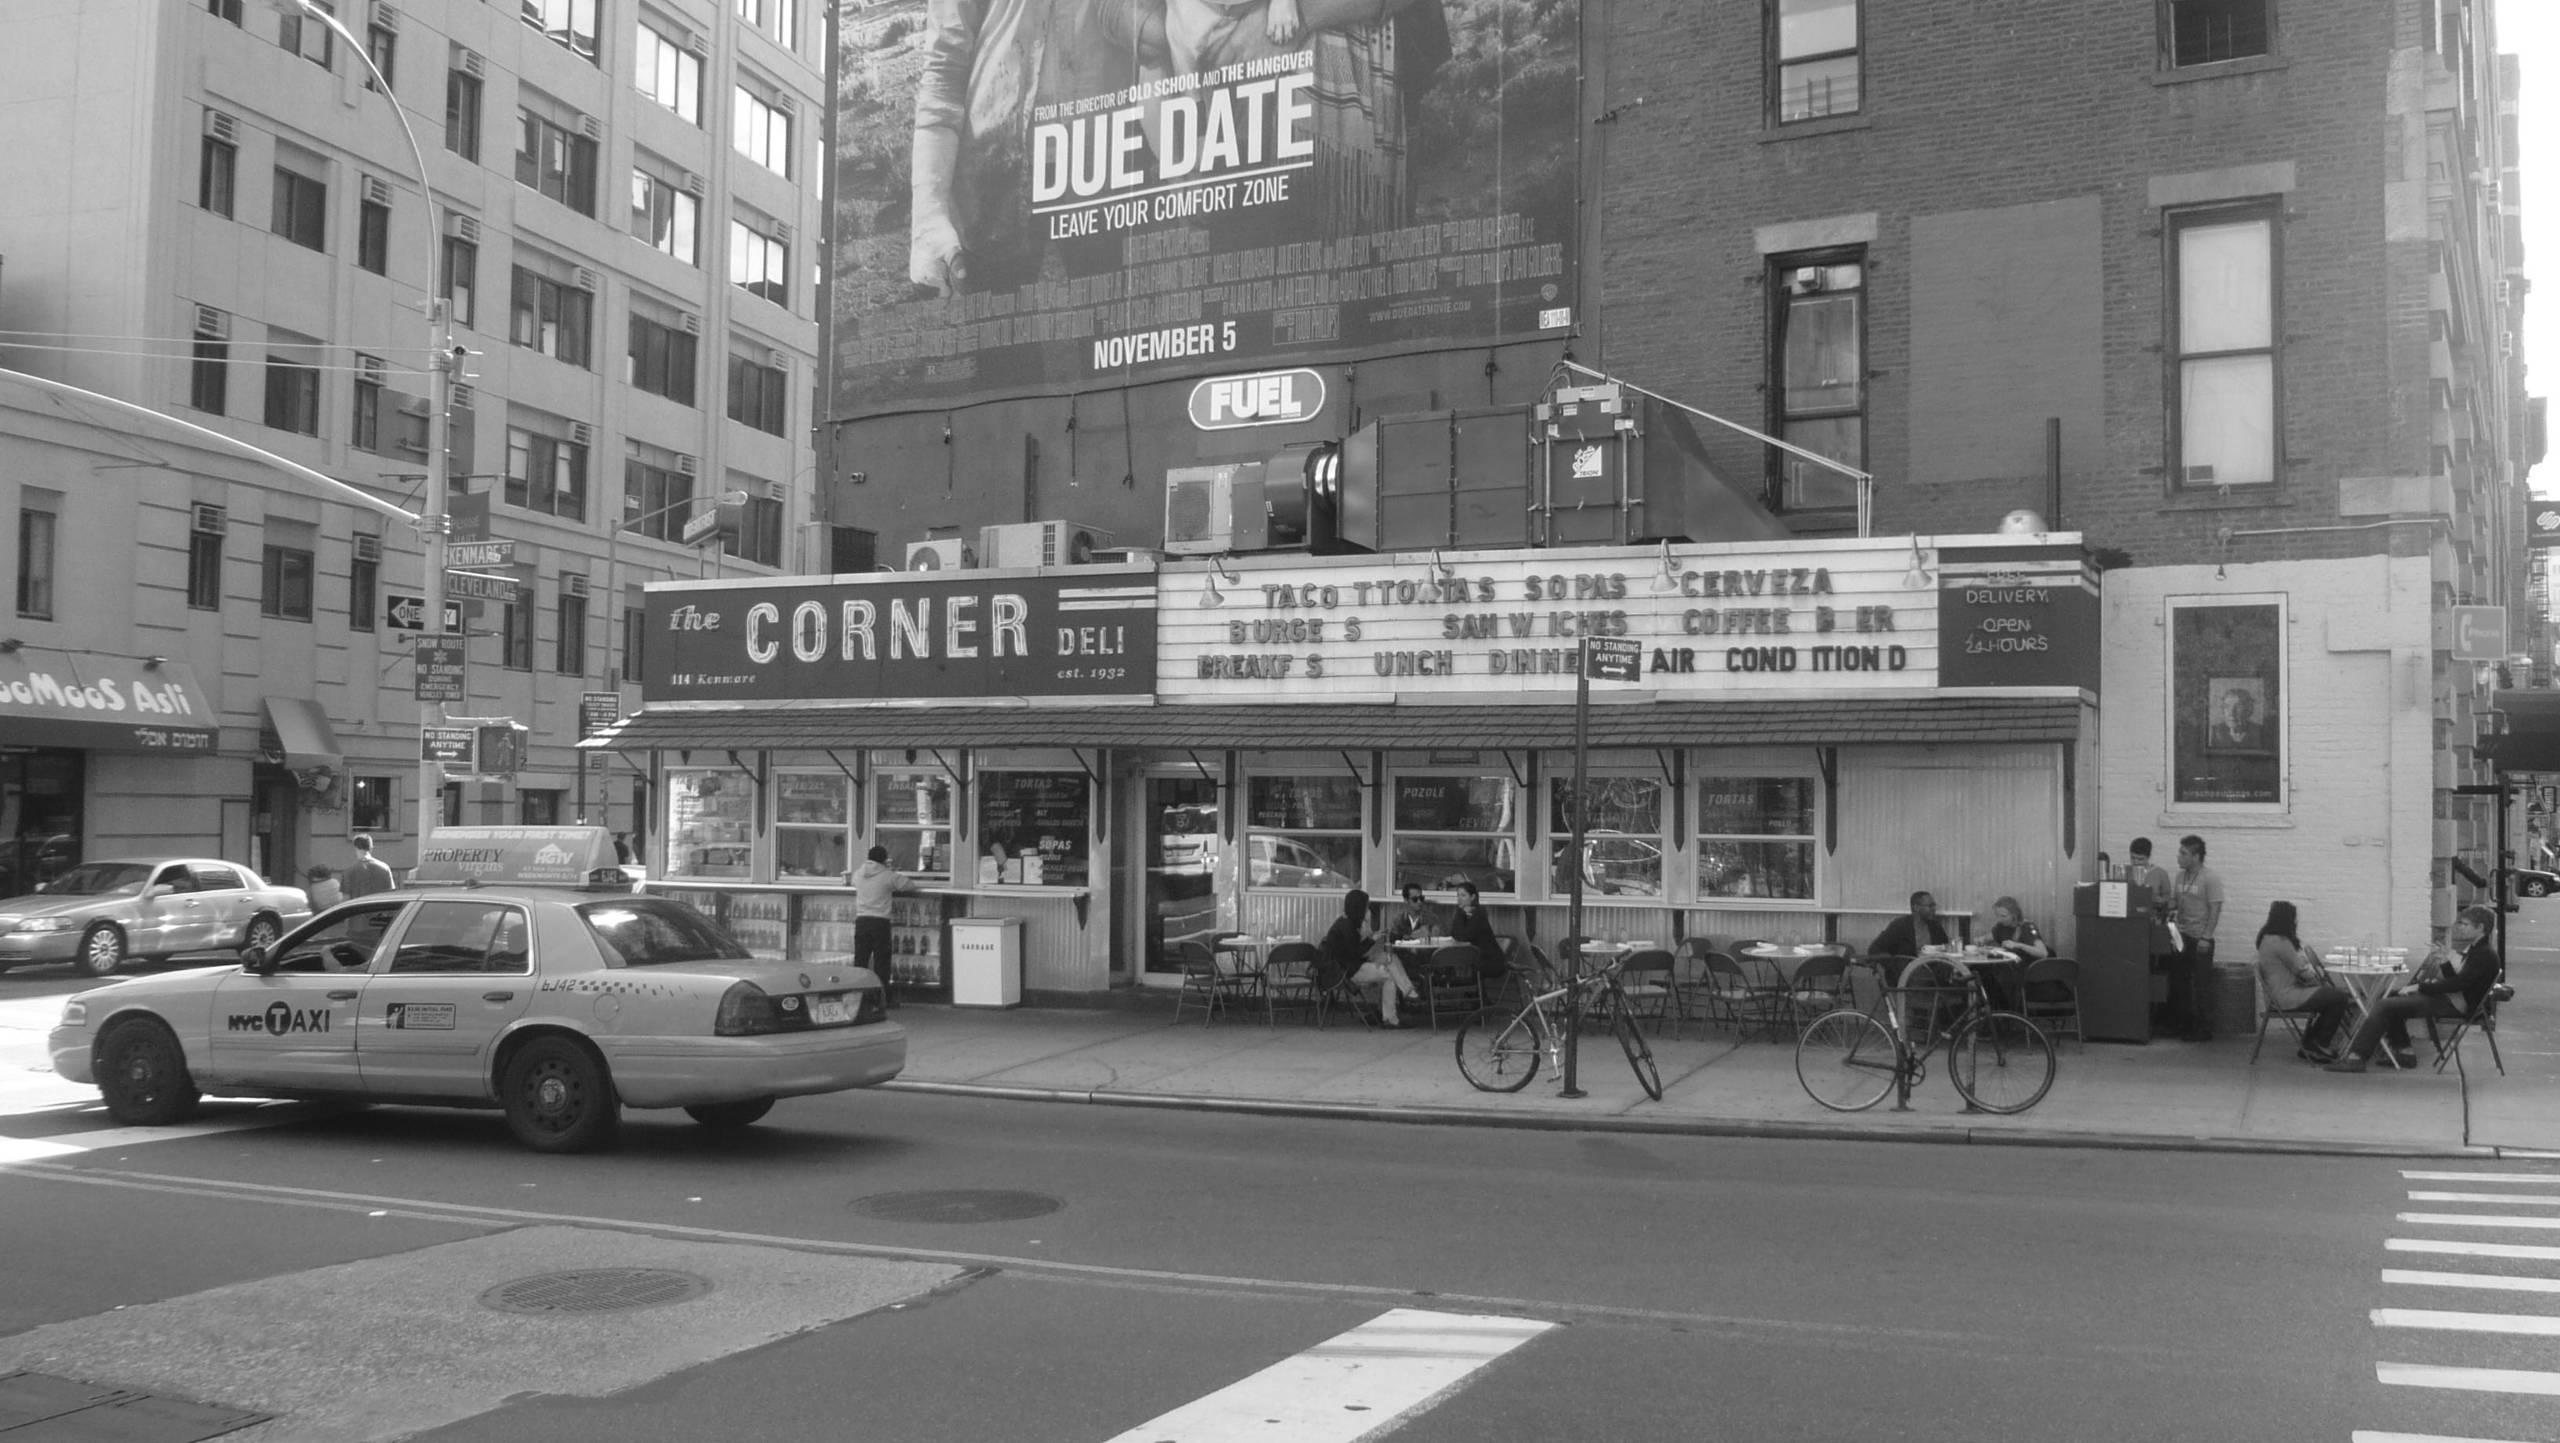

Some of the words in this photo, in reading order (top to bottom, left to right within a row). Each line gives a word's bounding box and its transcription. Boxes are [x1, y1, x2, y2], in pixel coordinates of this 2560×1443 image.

[1034, 106, 1057, 121] FROM
[1059, 102, 1074, 117] THE
[1076, 94, 1116, 114] DIRECTOR
[1117, 90, 1128, 106] OF
[1128, 83, 1151, 103] OLD
[1154, 73, 1201, 97] SCHOOL
[1202, 70, 1220, 87] AND
[1220, 63, 1244, 82] THE
[1246, 50, 1313, 78] HANGOVER
[1032, 106, 1144, 203] DUE
[1159, 72, 1314, 180] DATE
[1050, 209, 1098, 240] LEAVE
[1103, 200, 1148, 231] YOUR
[1154, 183, 1237, 222] COMFORT
[1242, 175, 1289, 206] ZONE
[1094, 323, 1214, 369] NOVEMBER
[1222, 320, 1236, 351] 5
[1210, 375, 1301, 421] FUEL
[501, 544, 513, 554] ST
[448, 575, 505, 599] CLEVELAND
[1262, 583, 1338, 609] TACO
[1524, 573, 1628, 601] SOPAS
[1681, 567, 1834, 598] CERVEZA
[1966, 589, 2049, 603] DELIVERY
[399, 606, 420, 620] ONE
[1548, 609, 1628, 636] ICHES
[1682, 606, 1790, 636] COFFEE
[1983, 617, 2031, 633] OPEN
[669, 604, 720, 630] the
[746, 593, 1028, 664] CORNER
[1058, 625, 1124, 656] DELI
[417, 639, 438, 648] SNOW
[441, 639, 465, 649] ROUTE
[1590, 641, 1600, 650] NO
[1604, 641, 1639, 653] STANDING
[1988, 636, 2049, 652] HOURS
[1198, 654, 1293, 680] BREAKF
[1374, 649, 1453, 676] UNCH
[1650, 646, 1695, 673] AIR
[1726, 645, 1797, 672] COND
[1595, 653, 1633, 665] ANYTIME
[417, 664, 427, 674] NO
[431, 664, 464, 675] STANDING
[1057, 668, 1084, 679] est.
[1090, 667, 1126, 680] 1932
[672, 673, 690, 686] 114
[698, 672, 756, 685] Kenmare
[132, 680, 192, 716] Asli
[424, 731, 435, 740] NO
[438, 732, 472, 741] STANDING
[430, 741, 467, 750] ANYTIME
[1014, 778, 1053, 790] TORTAS
[1403, 786, 1446, 799] POZOLE
[1708, 793, 1755, 806] TORTAS
[492, 830, 523, 839] YOUR
[523, 830, 554, 839] FIRST
[1038, 839, 1073, 851] SOPAS
[424, 848, 504, 863] PROPERTY
[533, 852, 573, 865] HGTV
[458, 861, 504, 877] virgins
[228, 1014, 263, 1031] NYC
[265, 1001, 330, 1036] TAXI
